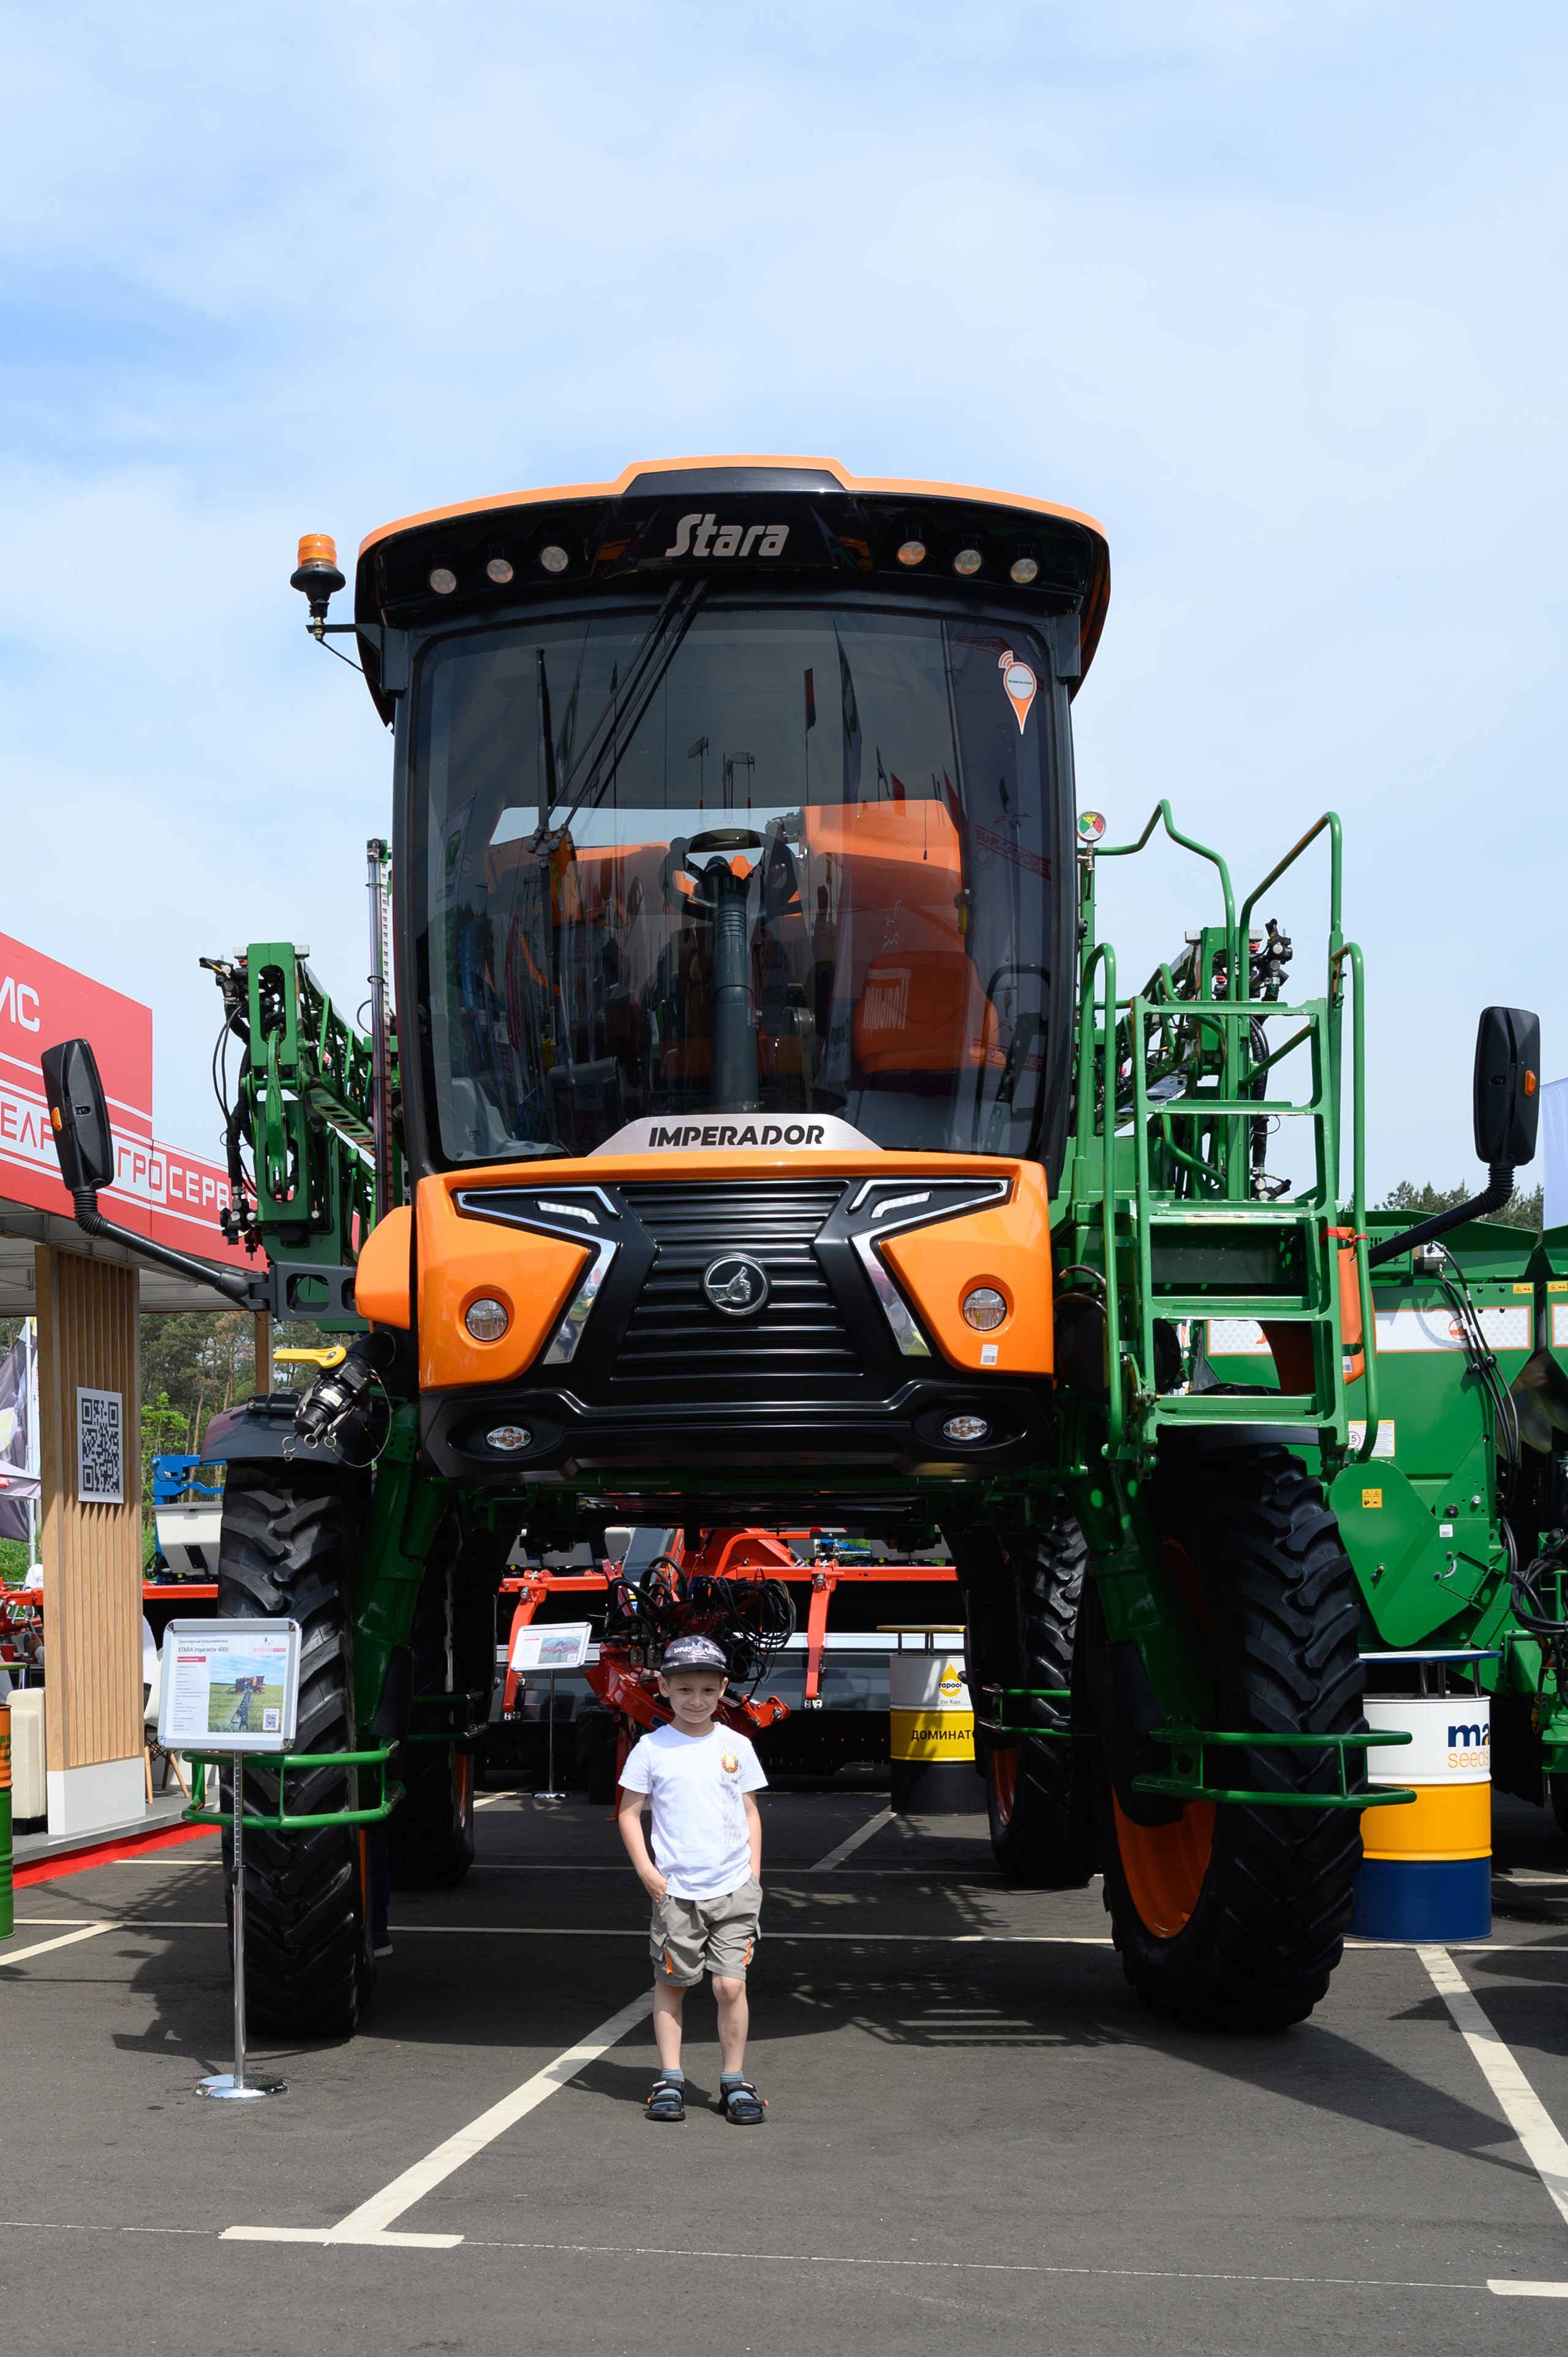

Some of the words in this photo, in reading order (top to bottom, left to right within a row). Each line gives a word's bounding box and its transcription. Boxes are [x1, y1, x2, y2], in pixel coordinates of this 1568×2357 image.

[665, 514, 789, 556] Stara
[649, 1125, 825, 1147] IMPERADOR
[911, 1729, 974, 1742] ДОМИНАТ
[1447, 1747, 1489, 1768] seeds
